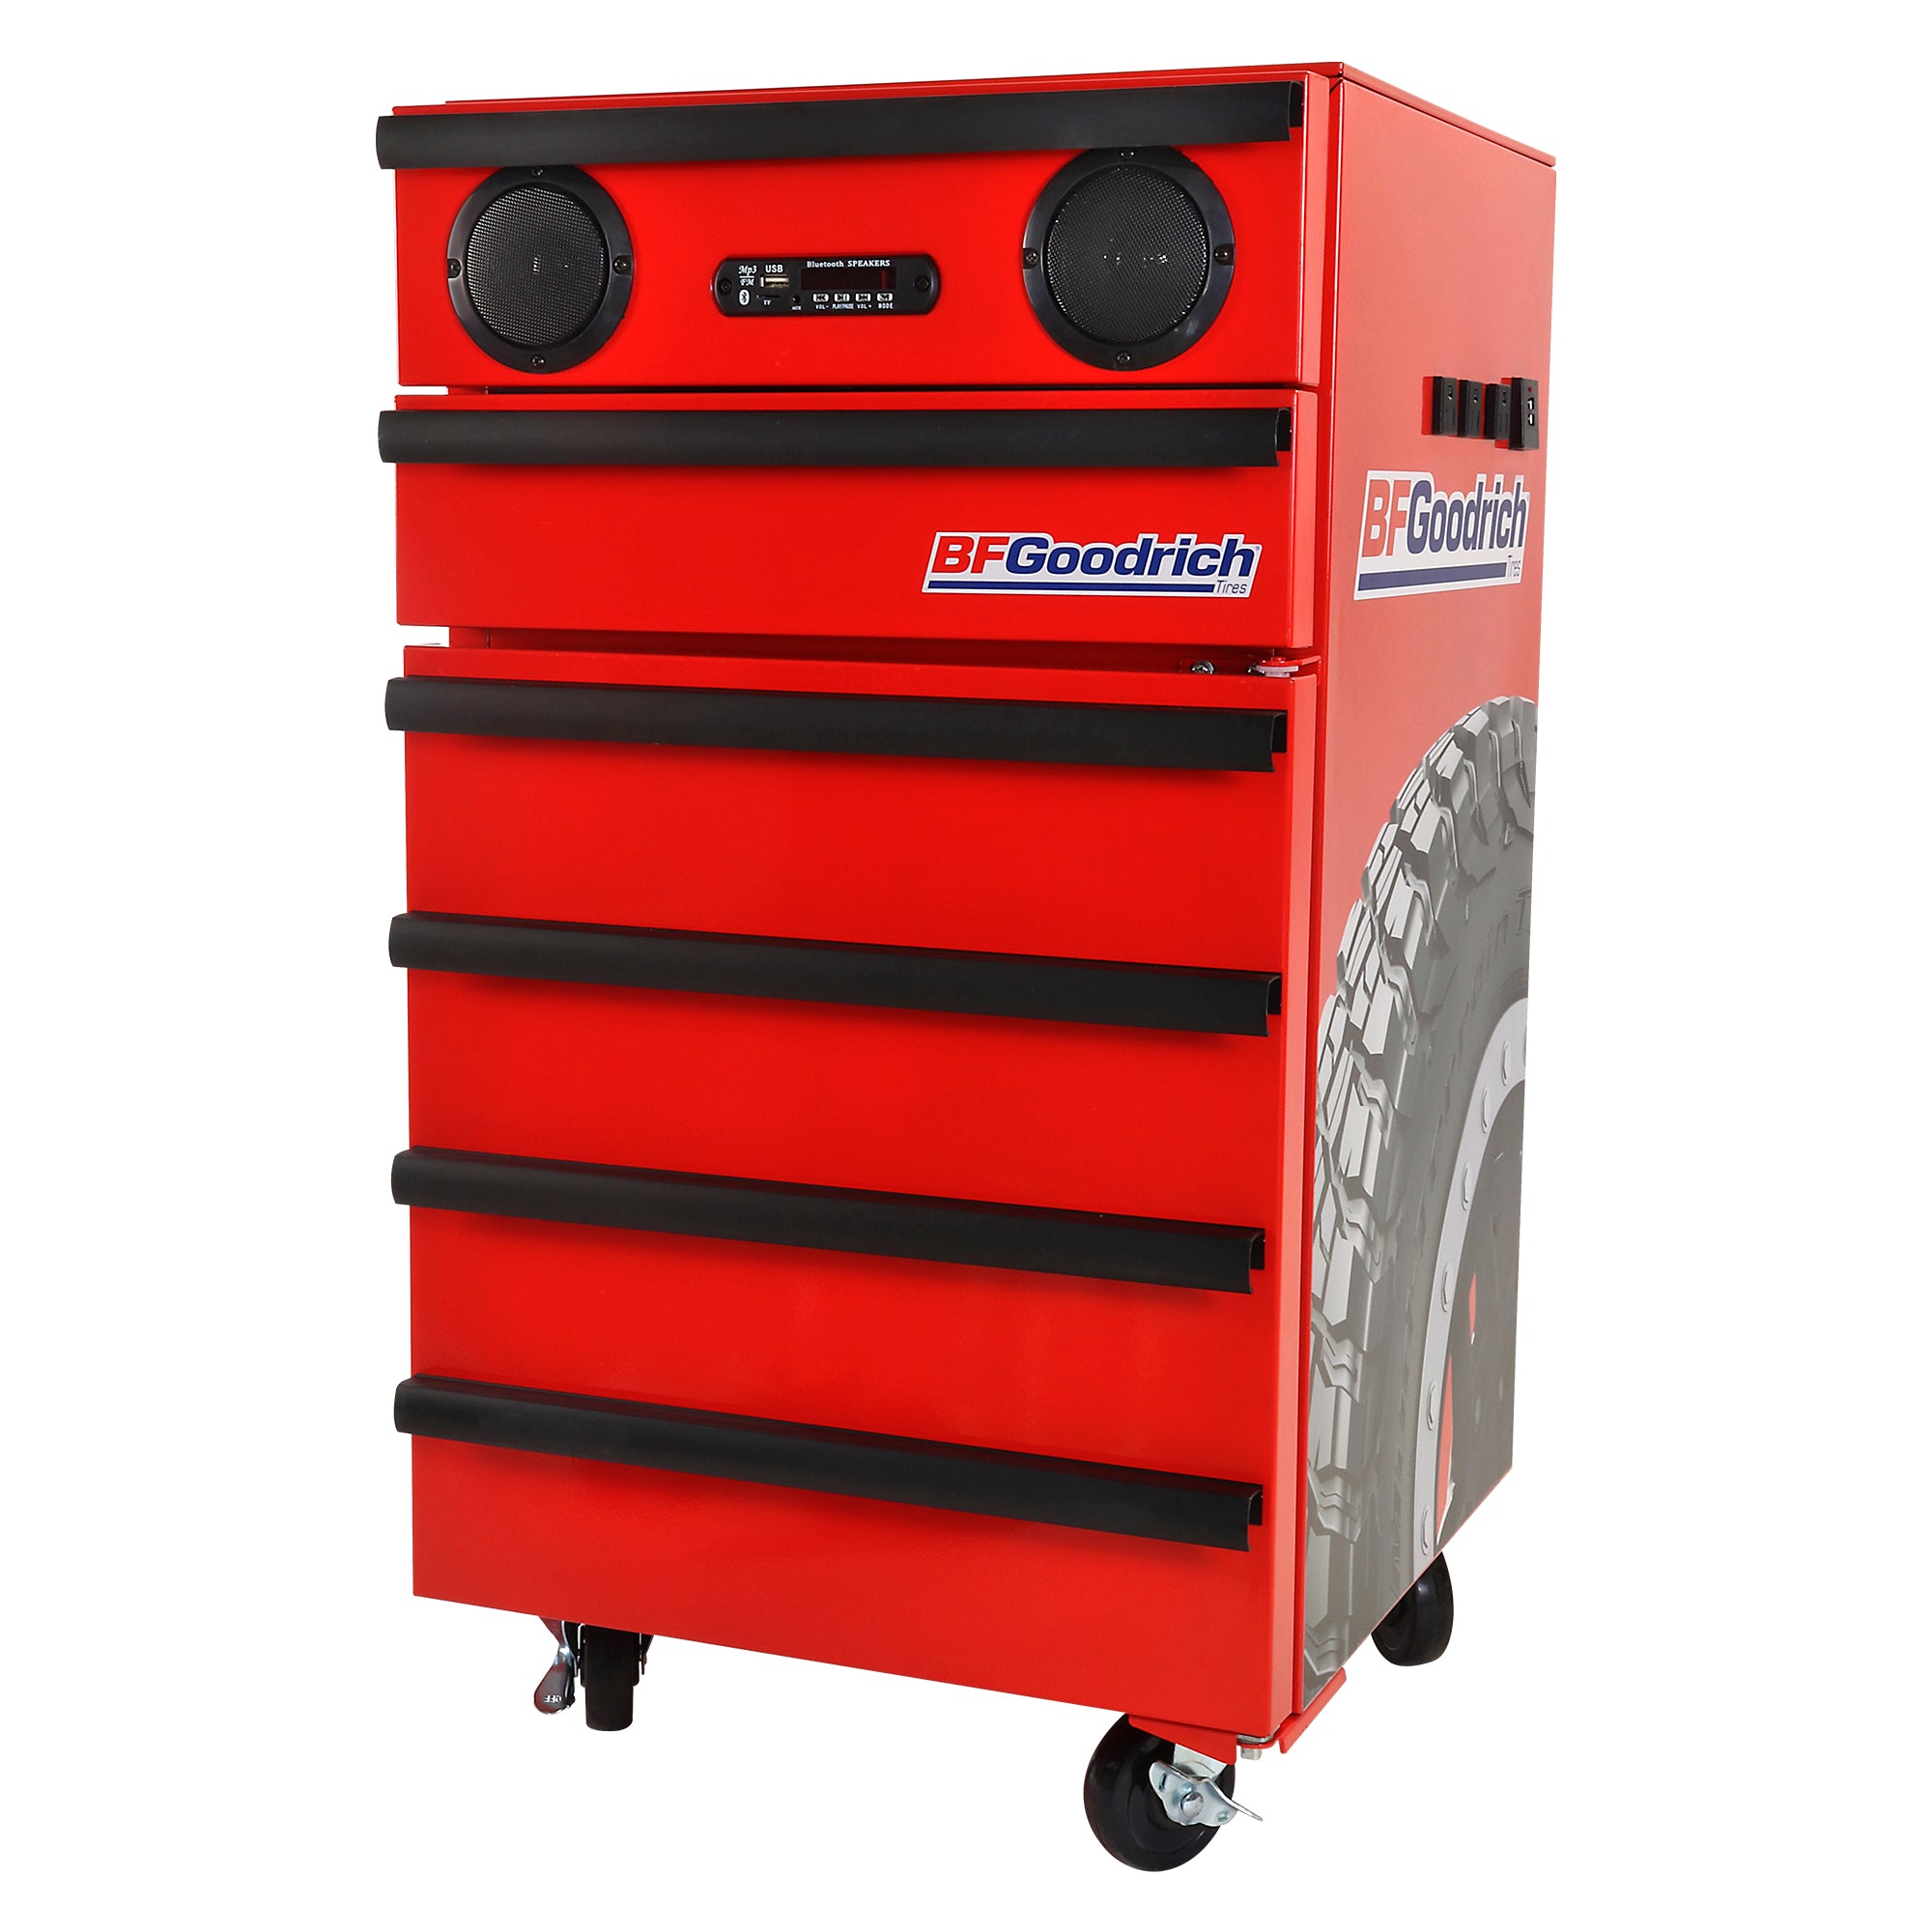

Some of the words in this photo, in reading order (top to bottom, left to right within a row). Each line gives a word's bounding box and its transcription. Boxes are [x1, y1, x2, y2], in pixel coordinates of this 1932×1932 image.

[765, 264, 783, 273] USB
[1361, 479, 1527, 557] BFGoodrich
[931, 535, 1255, 577] BFGoodrich
[1508, 554, 1521, 577] Tires
[1215, 580, 1247, 594] Tires
